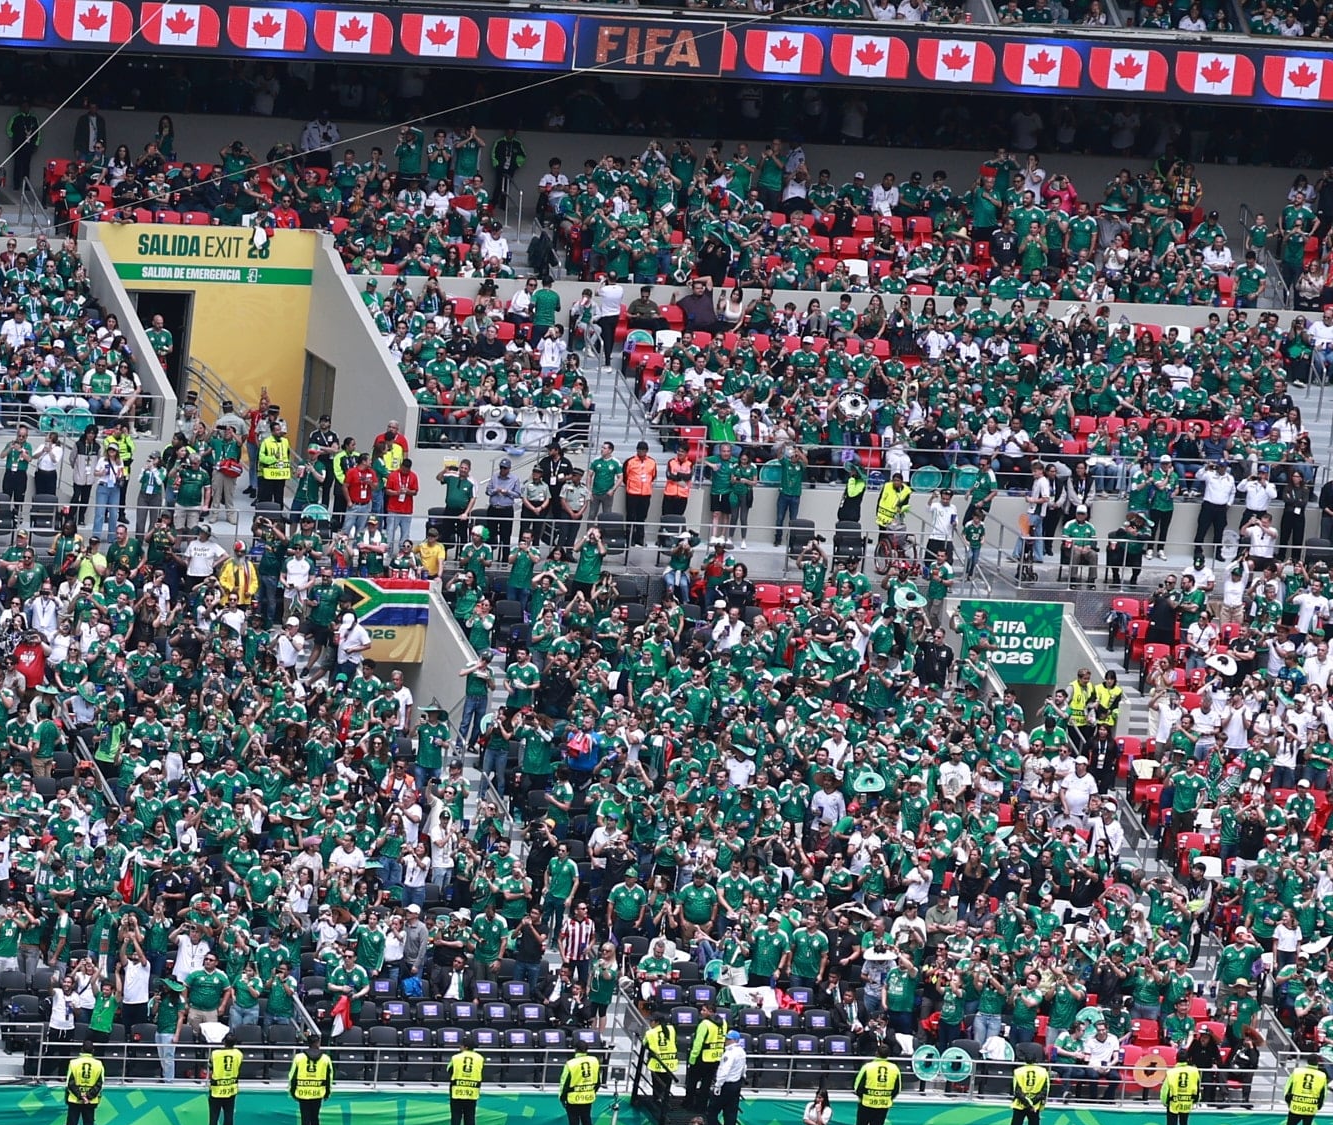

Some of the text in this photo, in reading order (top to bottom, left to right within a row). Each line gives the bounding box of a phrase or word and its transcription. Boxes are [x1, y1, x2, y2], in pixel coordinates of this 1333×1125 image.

[595, 26, 701, 68] FIFA
[137, 233, 201, 257] SALIDA
[204, 236, 245, 258] EXIT
[141, 266, 242, 281] SALIDA DE EMERGENCIA
[366, 629, 396, 640] 026
[993, 621, 1027, 635] FIFA
[1022, 636, 1055, 651] CUP
